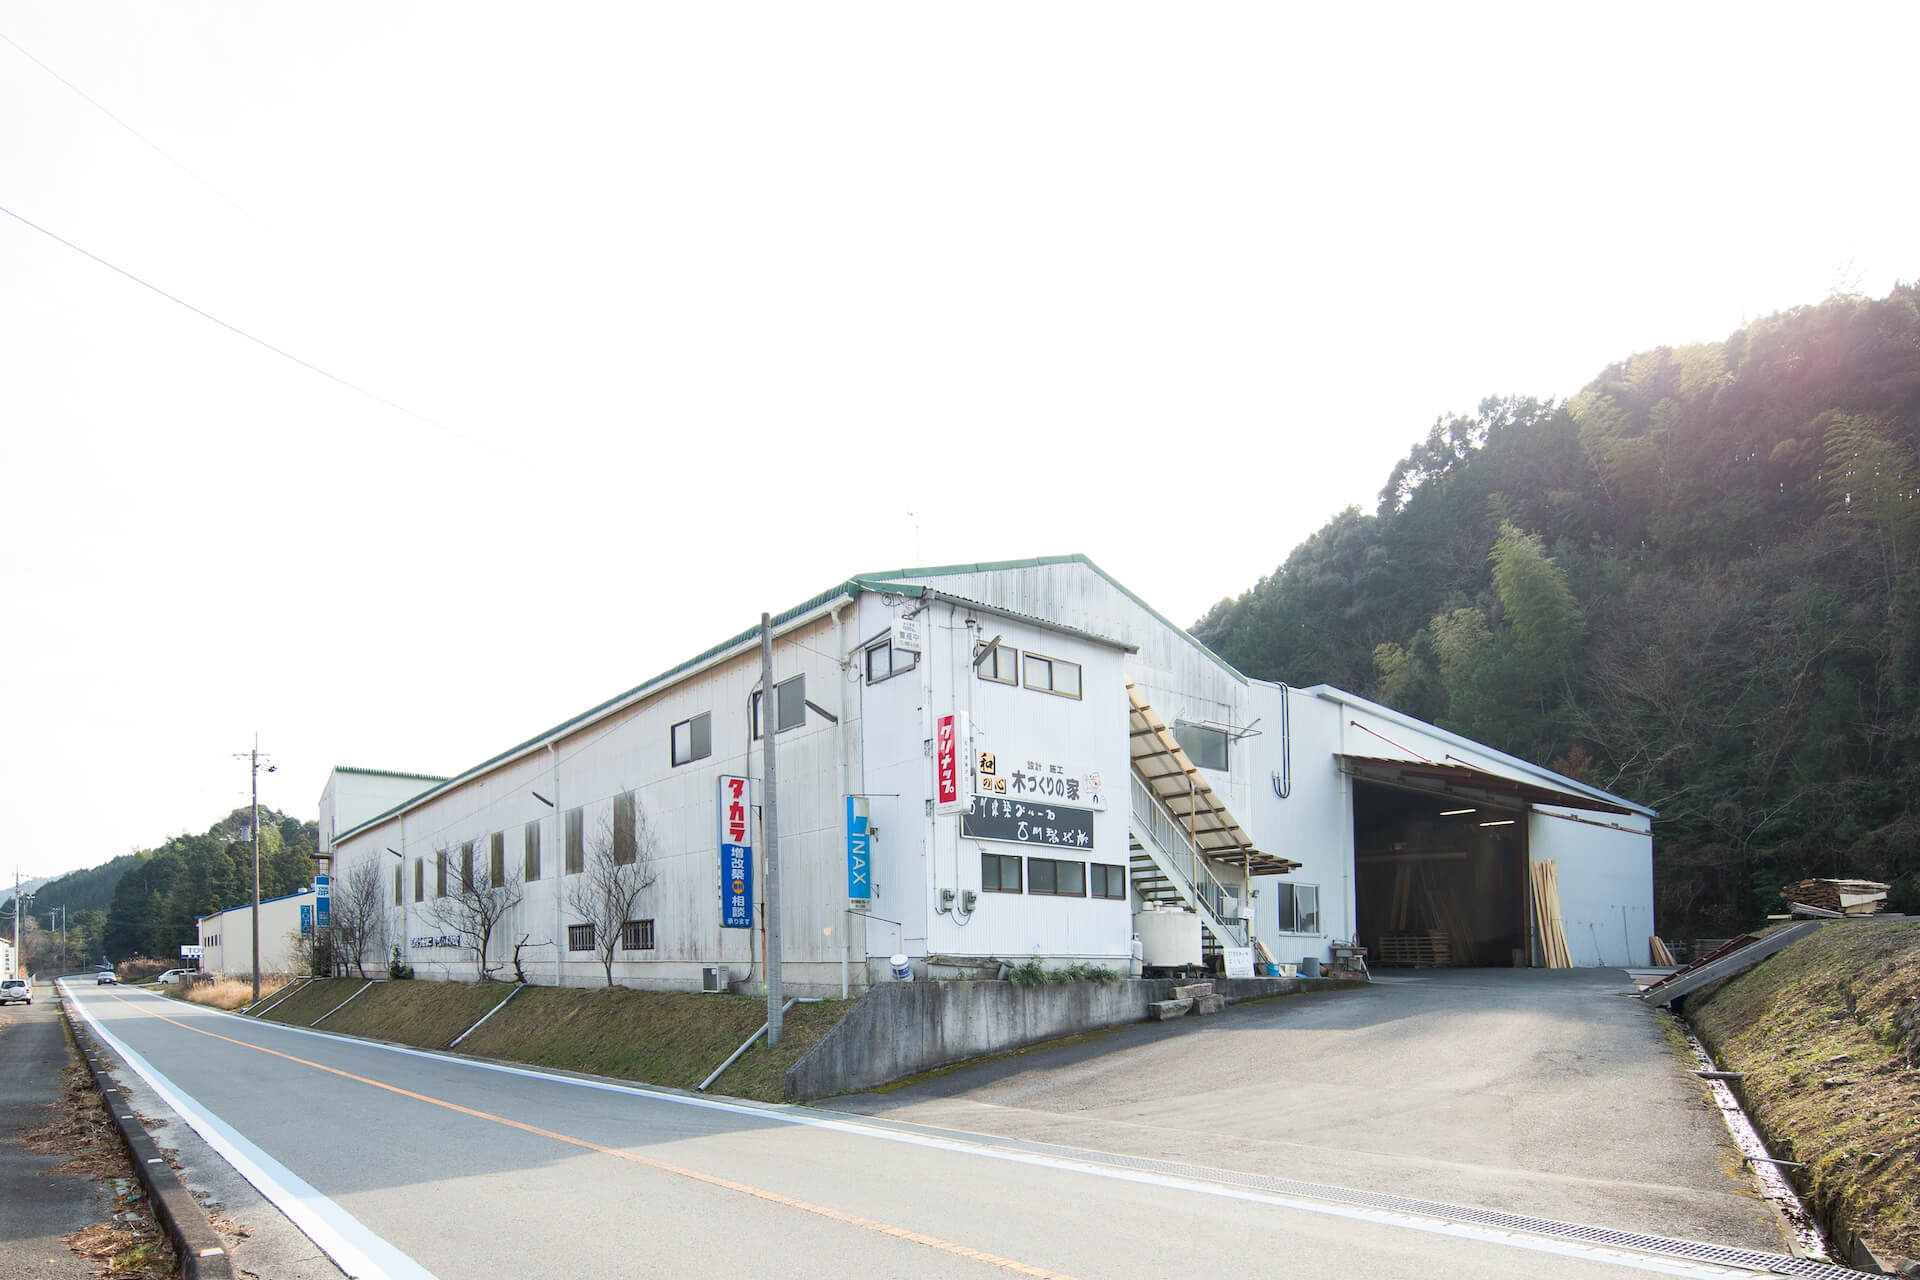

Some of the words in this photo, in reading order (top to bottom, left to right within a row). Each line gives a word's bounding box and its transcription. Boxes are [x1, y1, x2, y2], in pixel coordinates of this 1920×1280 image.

[940, 724, 954, 794] クリナップ
[980, 753, 993, 770] 和
[1027, 760, 1042, 771] 設計
[1050, 764, 1064, 775] 施工
[1012, 769, 1080, 801] 木づくりの家
[728, 778, 745, 842] タカラ
[731, 847, 745, 880] 増改築
[852, 832, 866, 885] INAX
[732, 895, 745, 918] 相談
